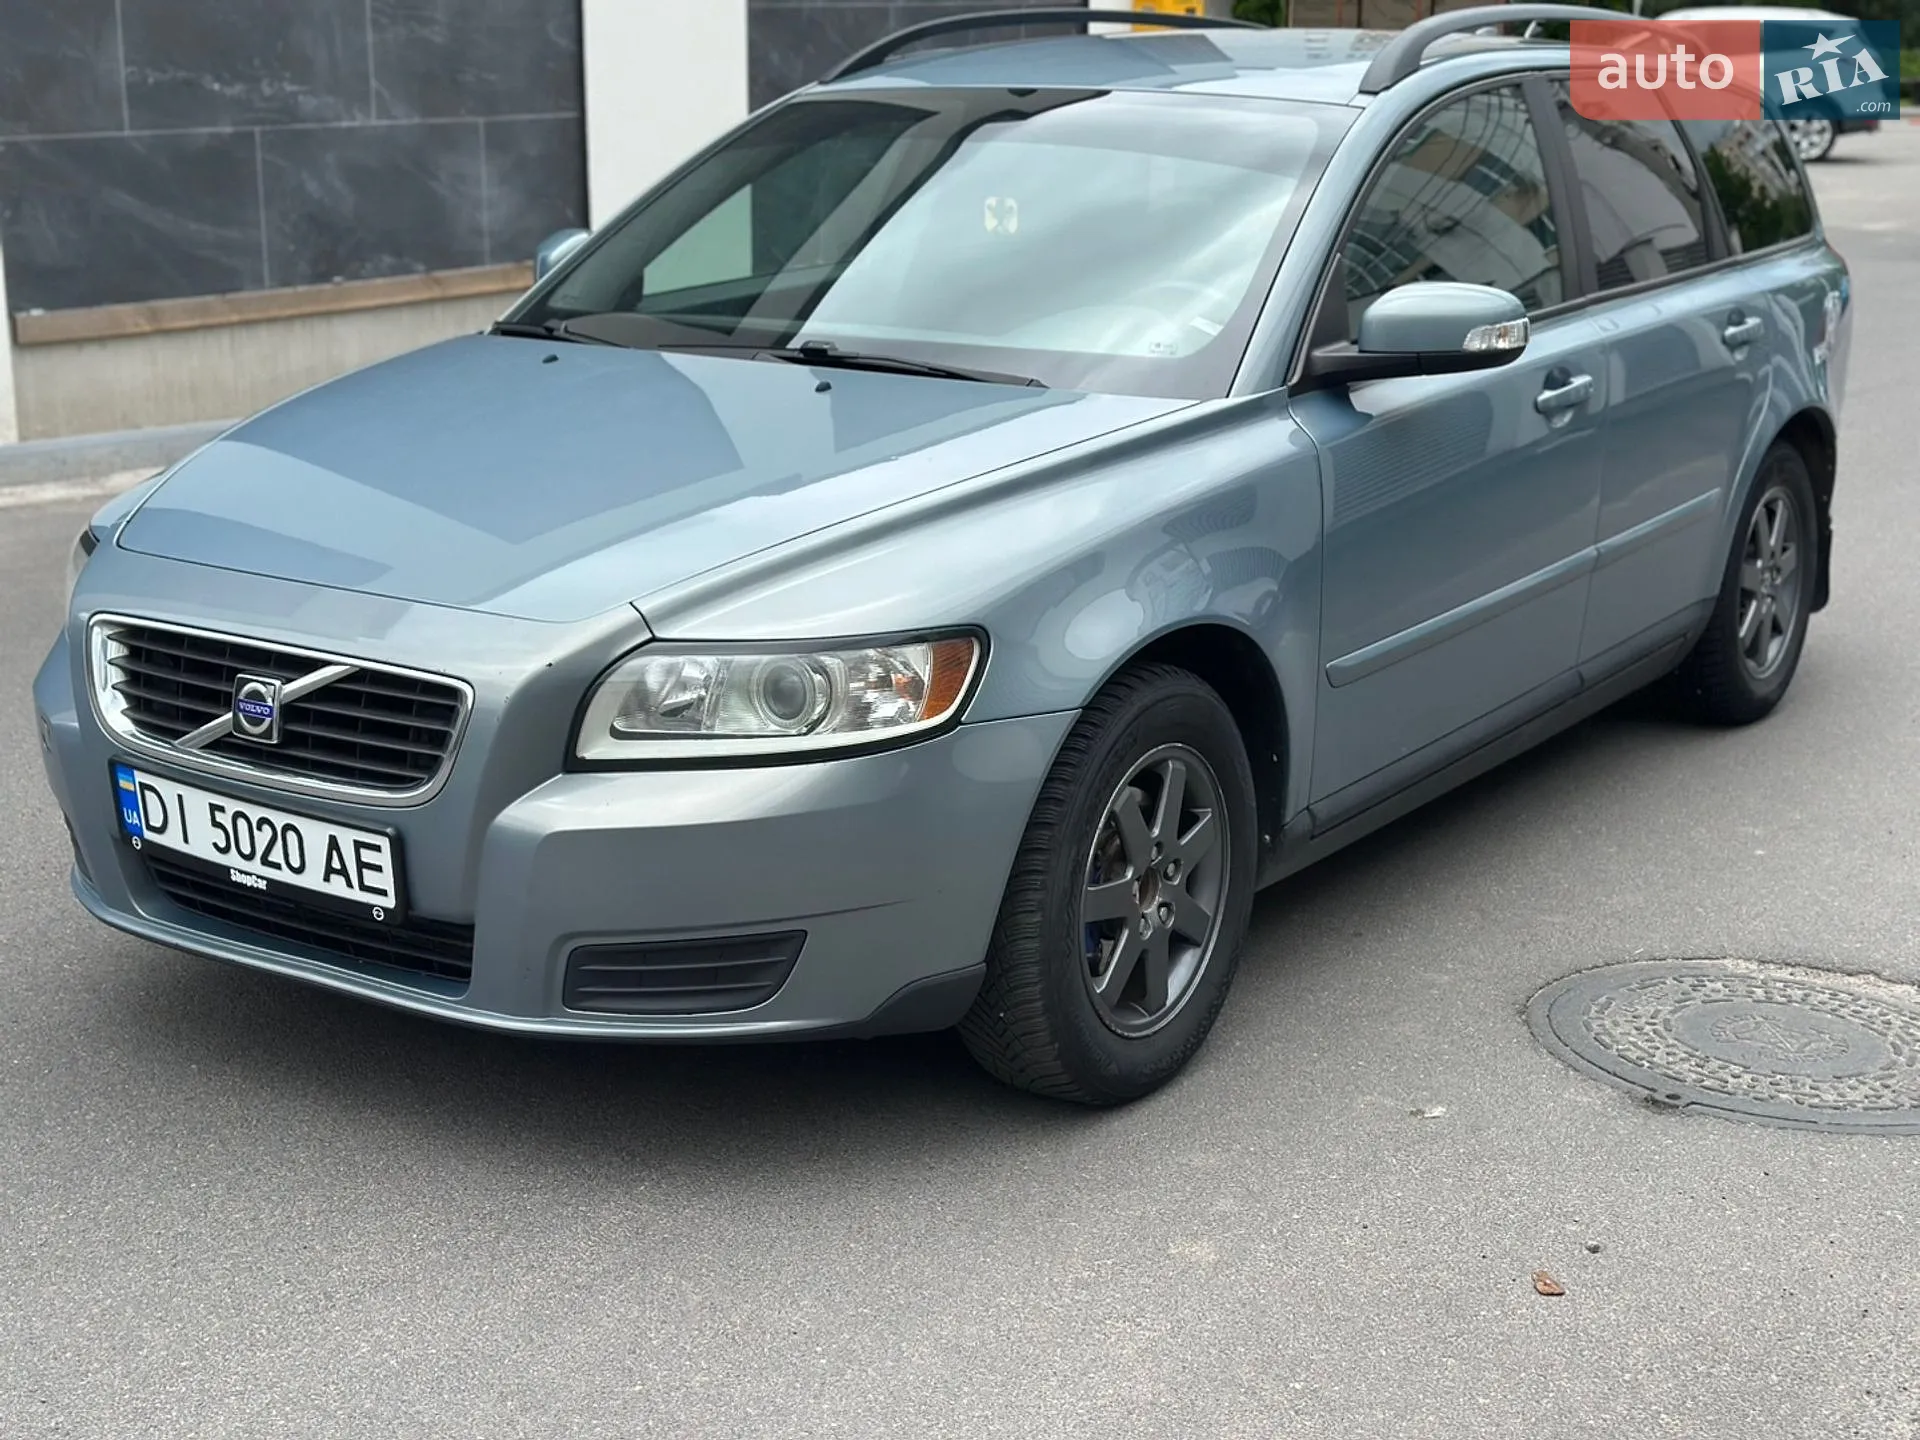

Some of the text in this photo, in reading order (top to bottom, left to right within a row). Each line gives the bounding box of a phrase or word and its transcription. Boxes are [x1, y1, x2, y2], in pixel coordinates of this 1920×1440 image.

[239, 701, 271, 715] VOLVO
[123, 807, 141, 827] UA
[138, 781, 388, 897] DI 5020 AE
[230, 868, 267, 890] ShopCar
